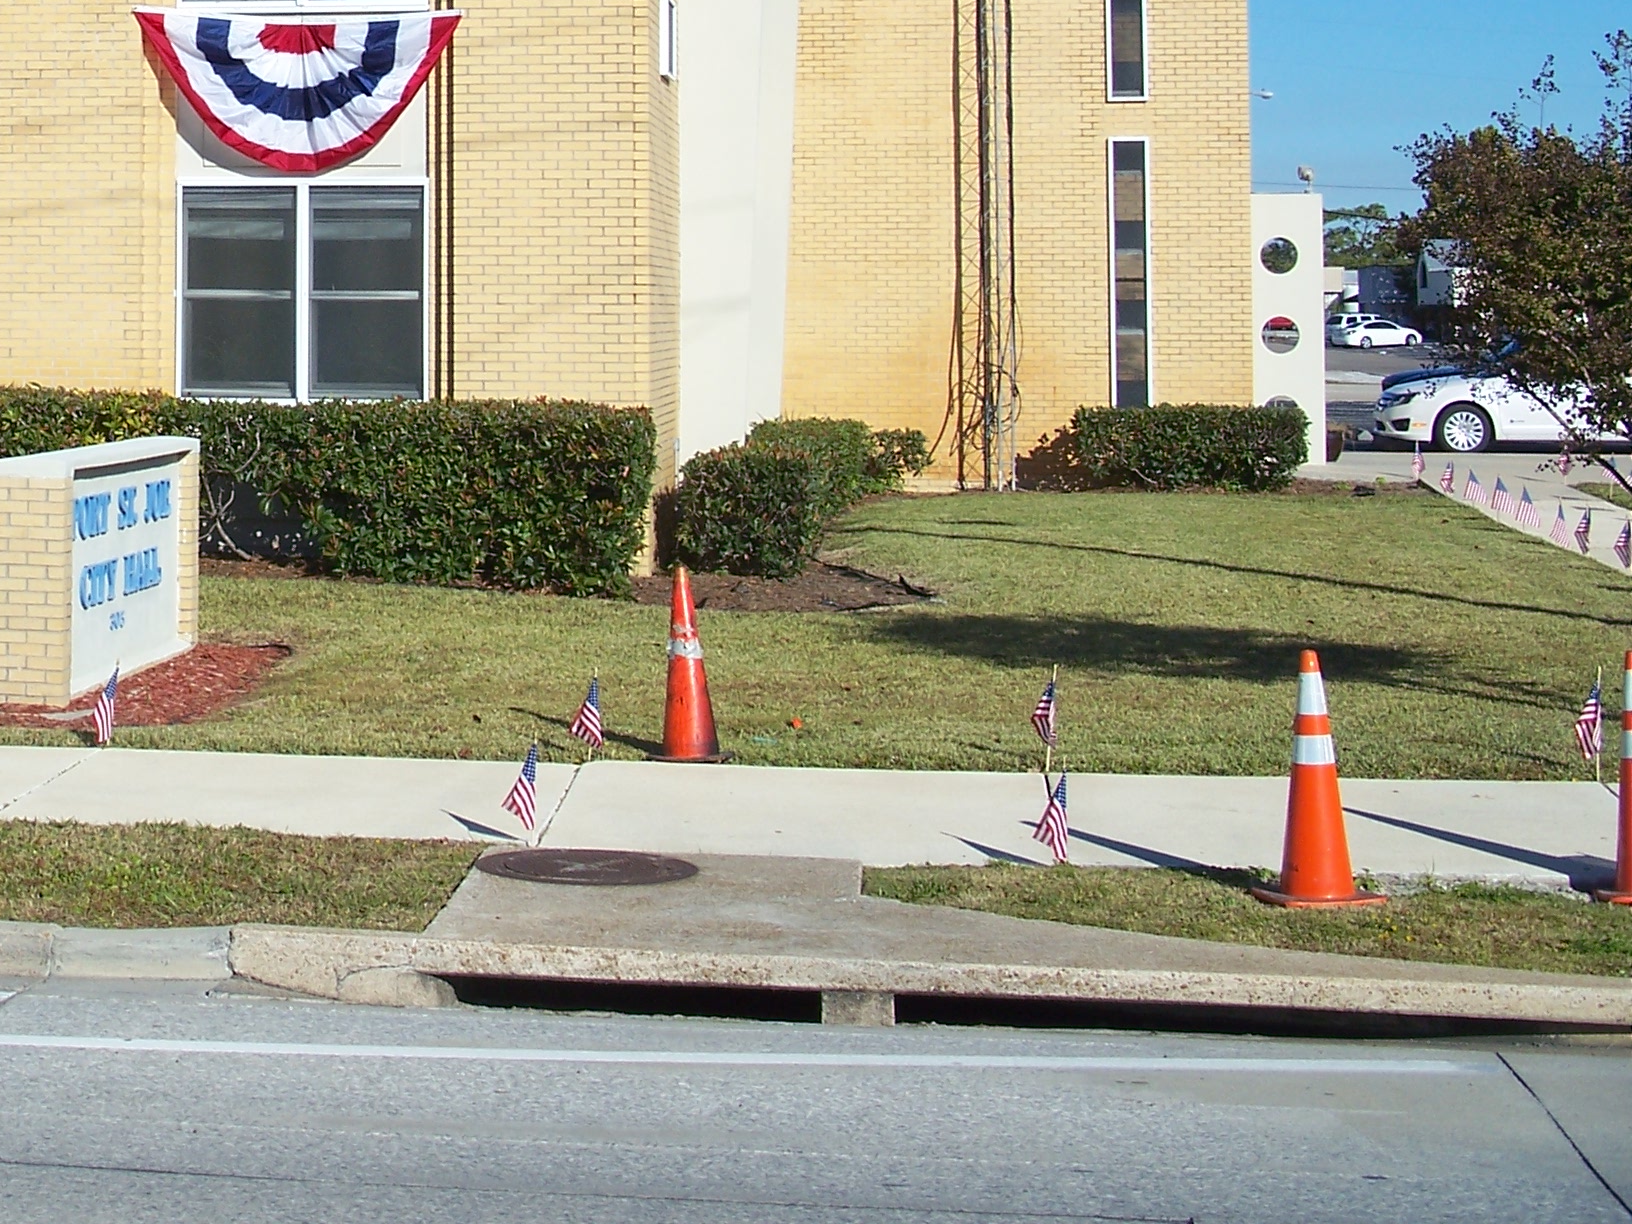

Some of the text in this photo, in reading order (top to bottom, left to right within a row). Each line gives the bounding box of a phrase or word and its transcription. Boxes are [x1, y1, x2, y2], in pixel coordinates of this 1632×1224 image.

[144, 478, 171, 524] JOE
[79, 546, 162, 610] CITY HALL
